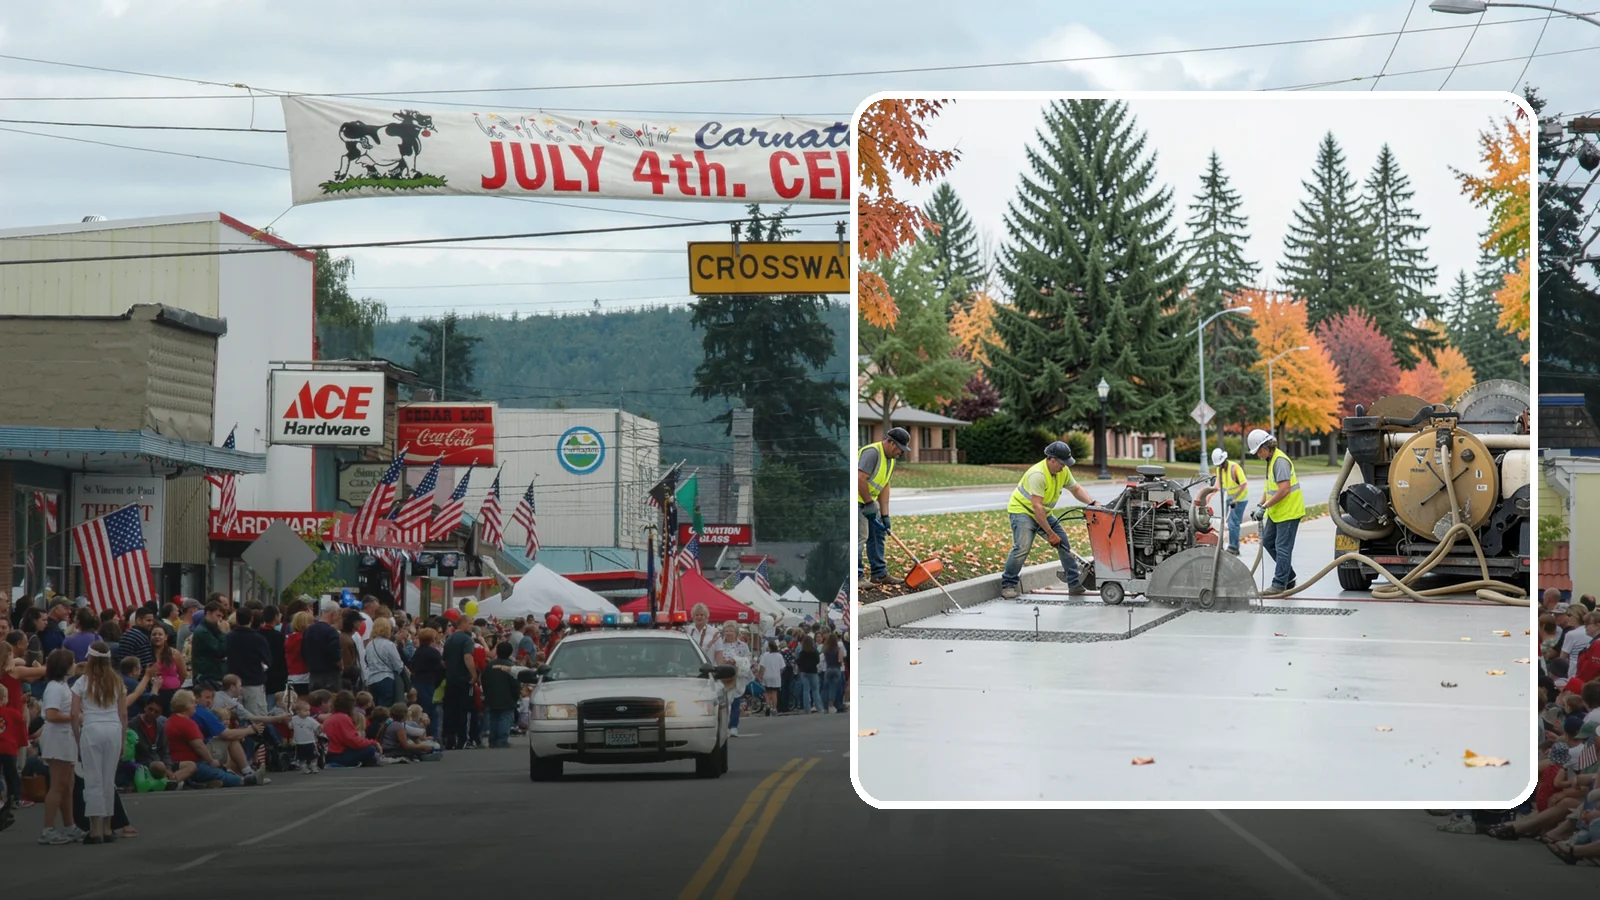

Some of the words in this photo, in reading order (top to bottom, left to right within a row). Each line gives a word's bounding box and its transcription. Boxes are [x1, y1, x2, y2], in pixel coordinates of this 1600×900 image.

[481, 141, 604, 192] JULY
[633, 149, 746, 198] 4th.
[697, 254, 850, 280] CROSSWA
[282, 380, 374, 420] ACE
[405, 409, 452, 421] CEDAR
[283, 421, 370, 436] Hardware
[353, 467, 384, 478] Simpl
[95, 484, 123, 495] Vincent
[126, 486, 135, 495] de
[138, 486, 155, 495] Paul
[688, 526, 741, 535] CRNATION
[699, 535, 730, 543] GLASS
